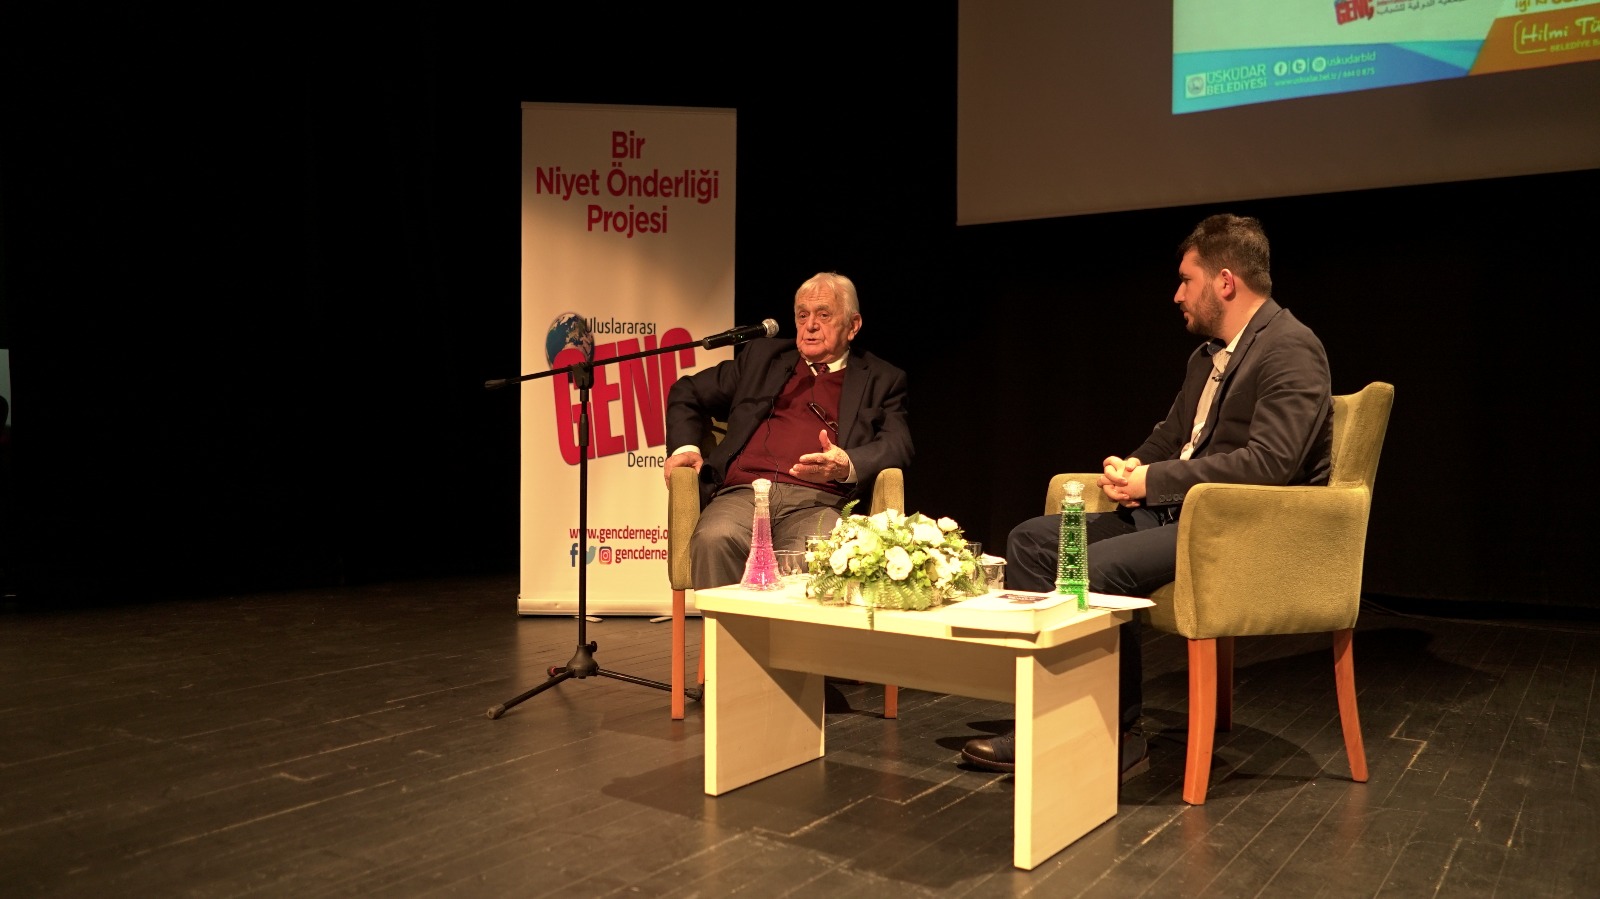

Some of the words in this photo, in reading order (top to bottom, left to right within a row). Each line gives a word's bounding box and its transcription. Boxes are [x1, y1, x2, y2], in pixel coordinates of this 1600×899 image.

[1521, 23, 1568, 45] Hilmi
[612, 130, 646, 159] Bir
[536, 166, 600, 201] Niyet
[606, 161, 719, 204] Önderliği
[587, 204, 668, 238] Projesi
[583, 317, 657, 335] Uluslararası
[627, 451, 665, 468] Derne
[569, 525, 668, 543] ww.gencdernegi.o
[615, 546, 668, 563] gencderne
